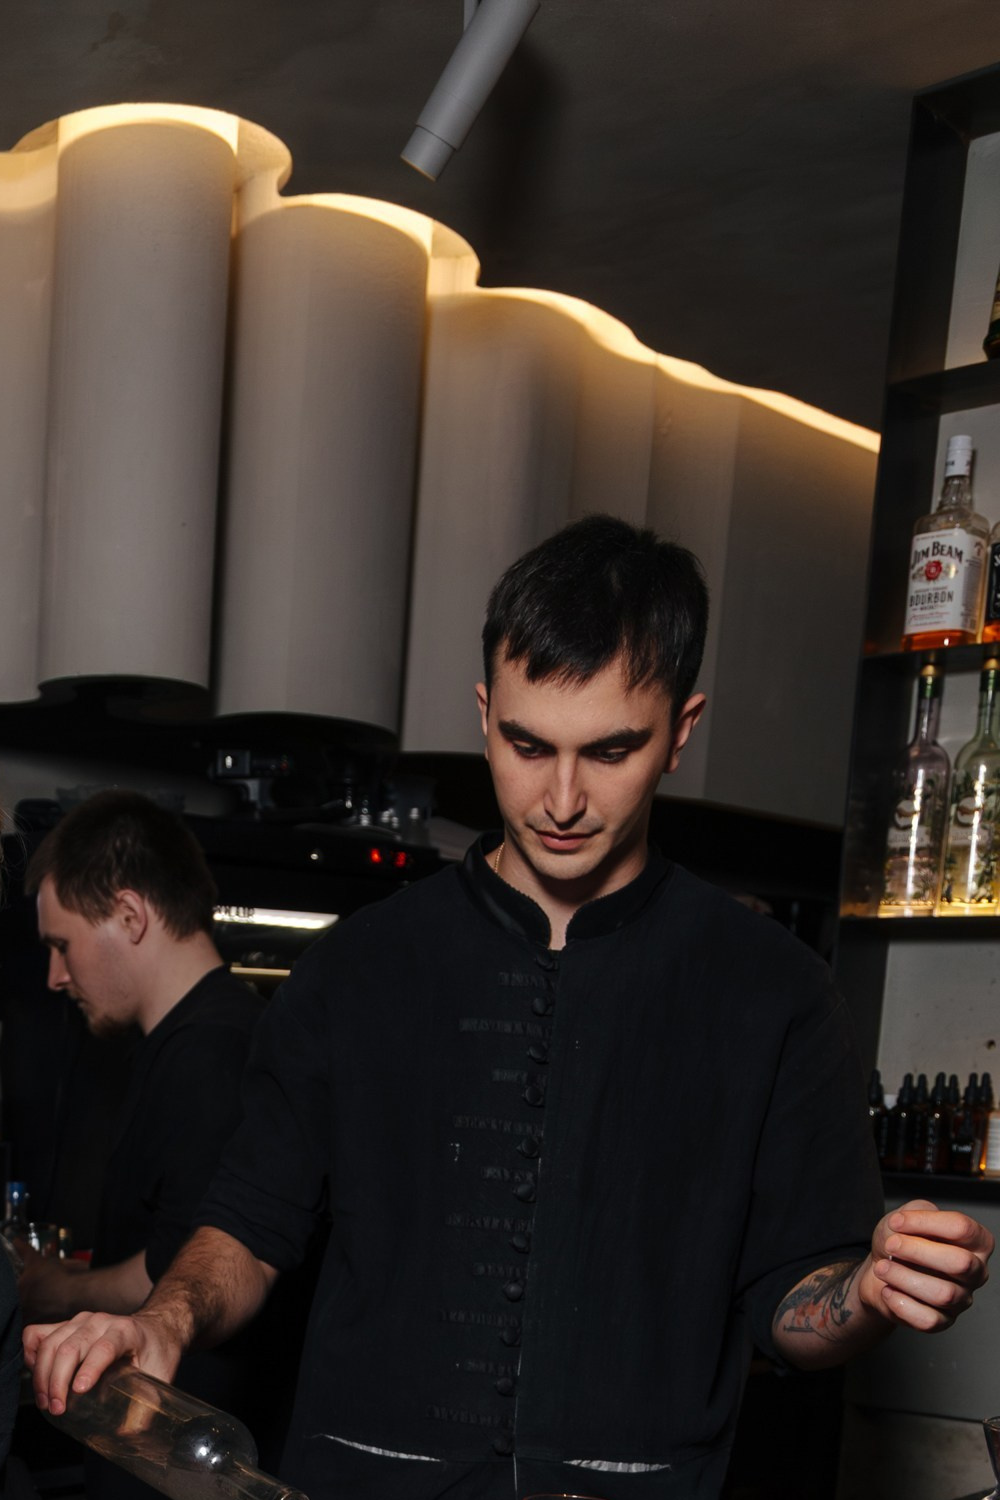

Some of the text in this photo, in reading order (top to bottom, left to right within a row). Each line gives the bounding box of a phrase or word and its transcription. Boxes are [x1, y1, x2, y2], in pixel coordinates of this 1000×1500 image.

[910, 541, 963, 570] JIM BEAM
[909, 590, 954, 607] BOURBON
